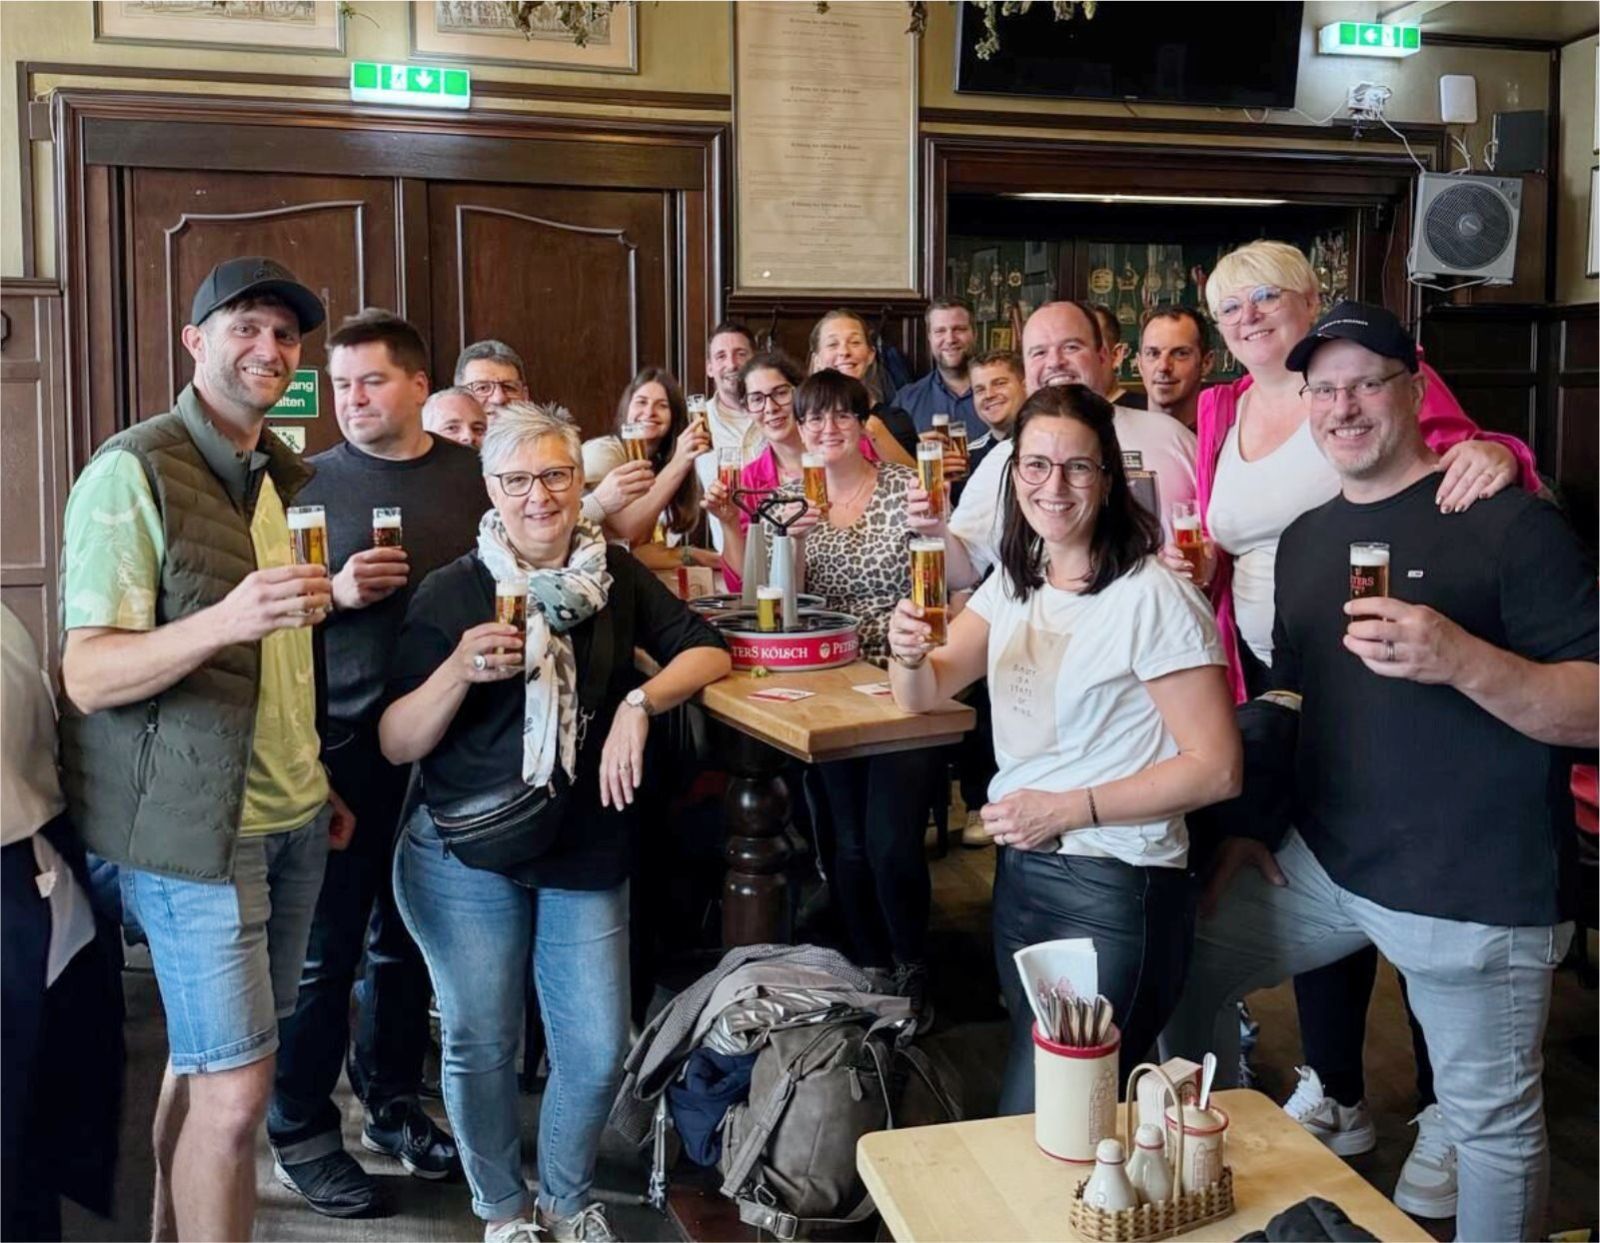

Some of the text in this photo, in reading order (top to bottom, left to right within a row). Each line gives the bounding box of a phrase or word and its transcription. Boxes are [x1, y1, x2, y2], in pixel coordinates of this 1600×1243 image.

[286, 381, 314, 393] ang
[275, 396, 305, 407] alten
[732, 645, 808, 660] TERS KÖLSCH
